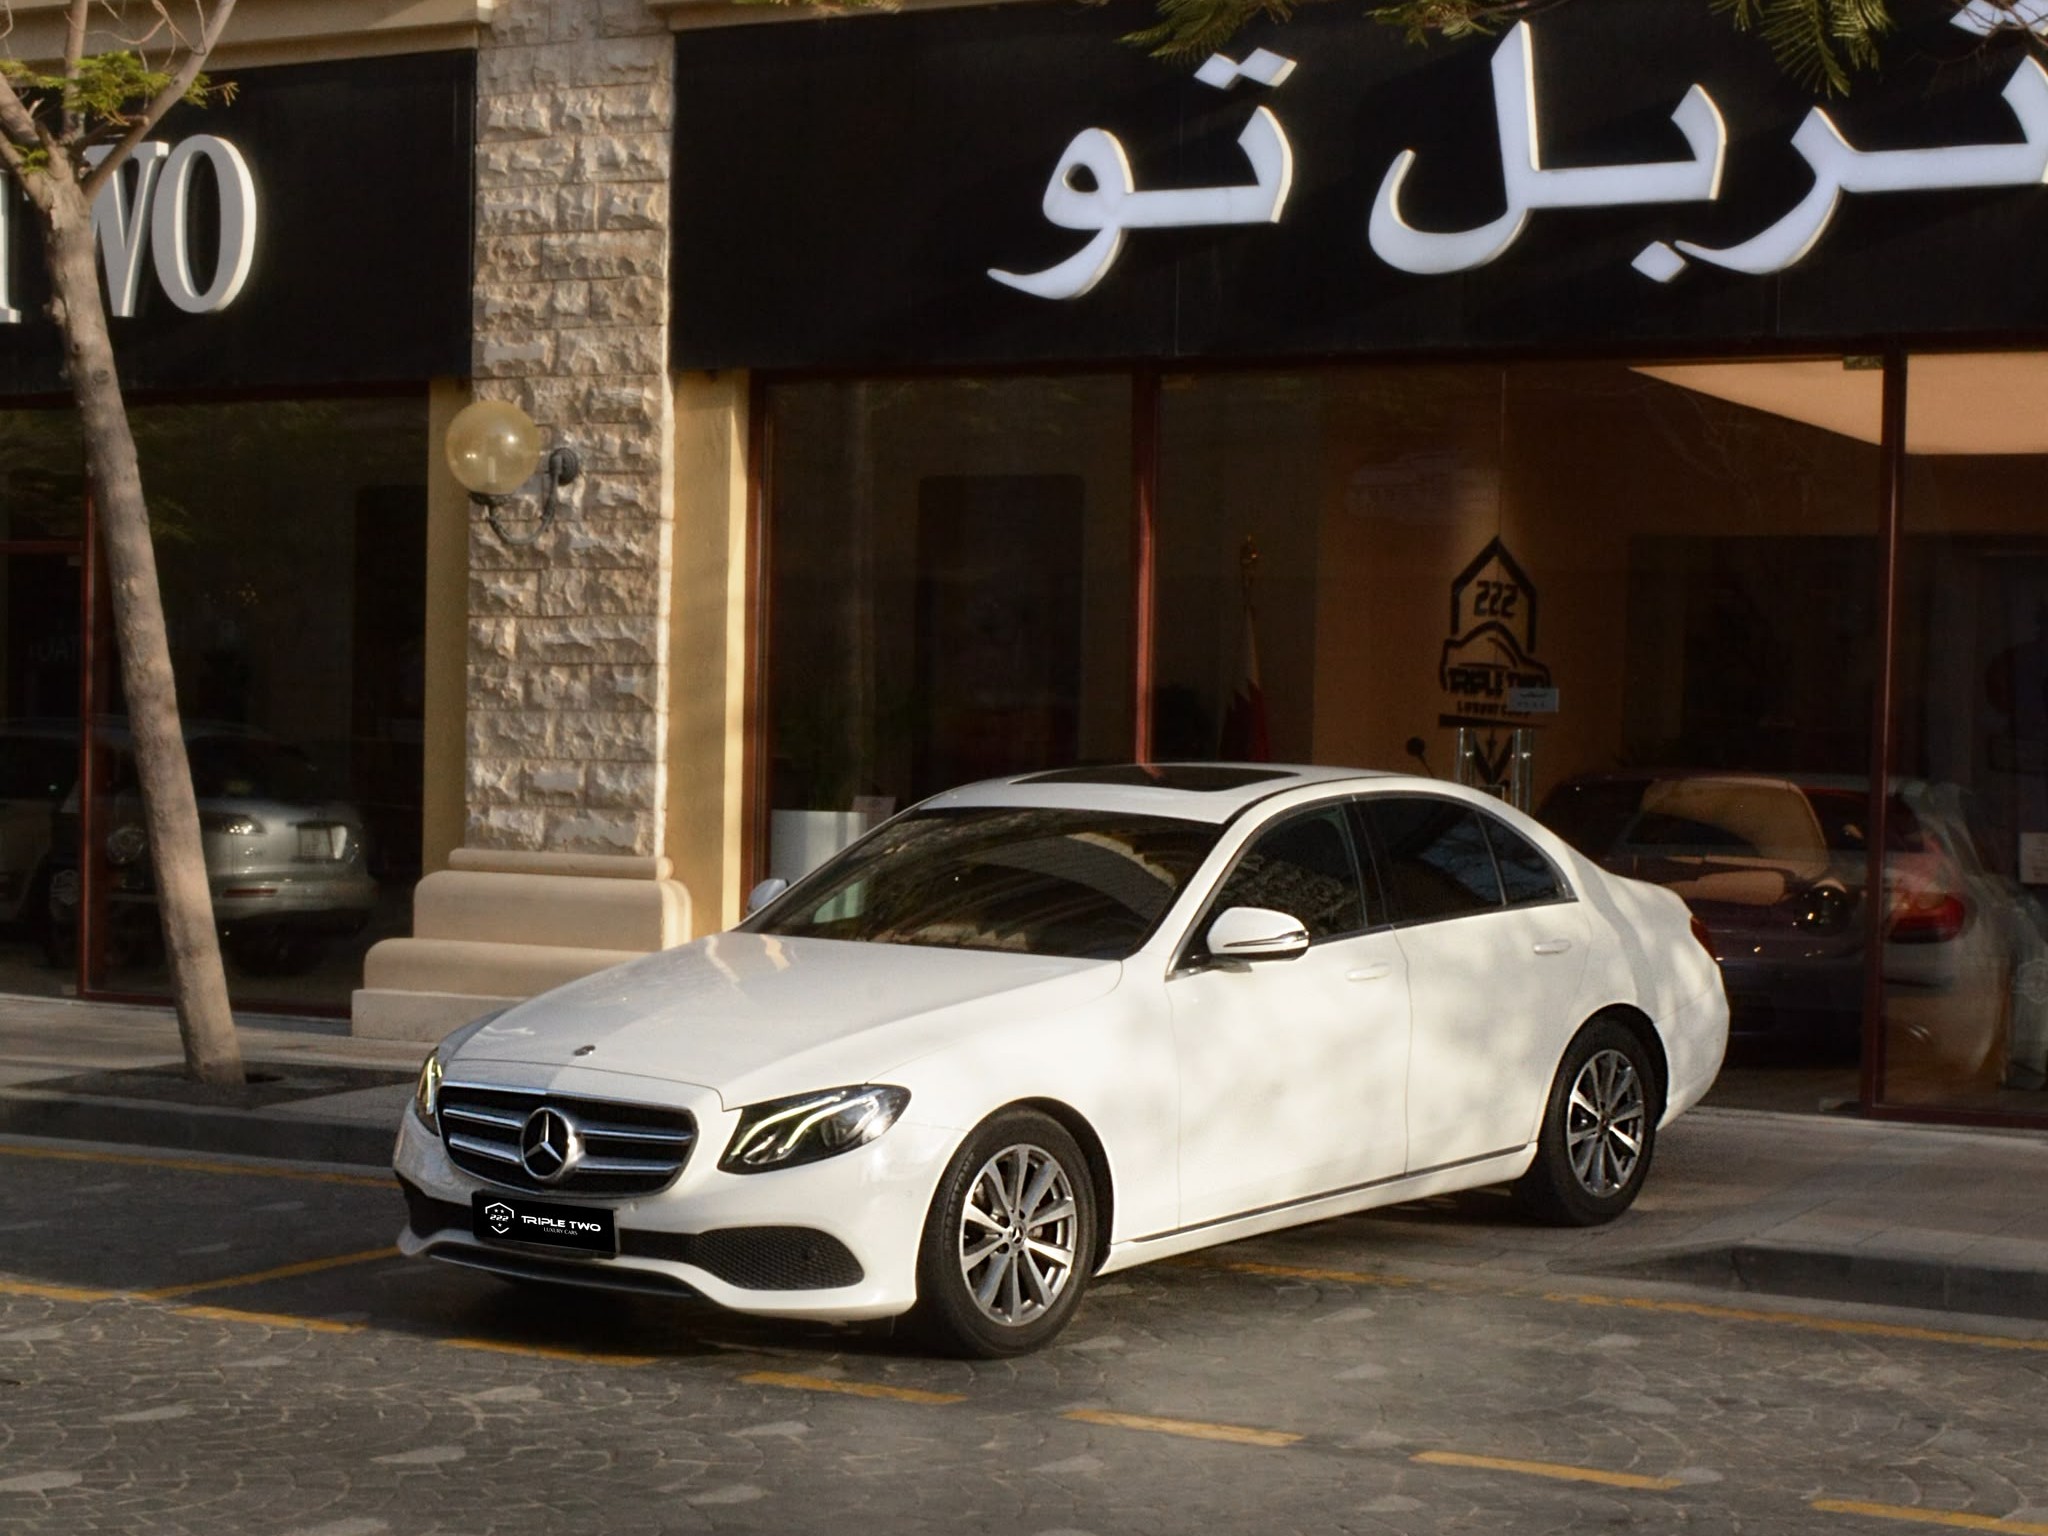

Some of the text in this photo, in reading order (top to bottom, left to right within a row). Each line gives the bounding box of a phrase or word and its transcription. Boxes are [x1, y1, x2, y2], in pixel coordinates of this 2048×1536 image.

[988, 48, 1296, 300] تو
[490, 1214, 509, 1222] 222
[521, 1215, 602, 1232] TRIPLE TWO
